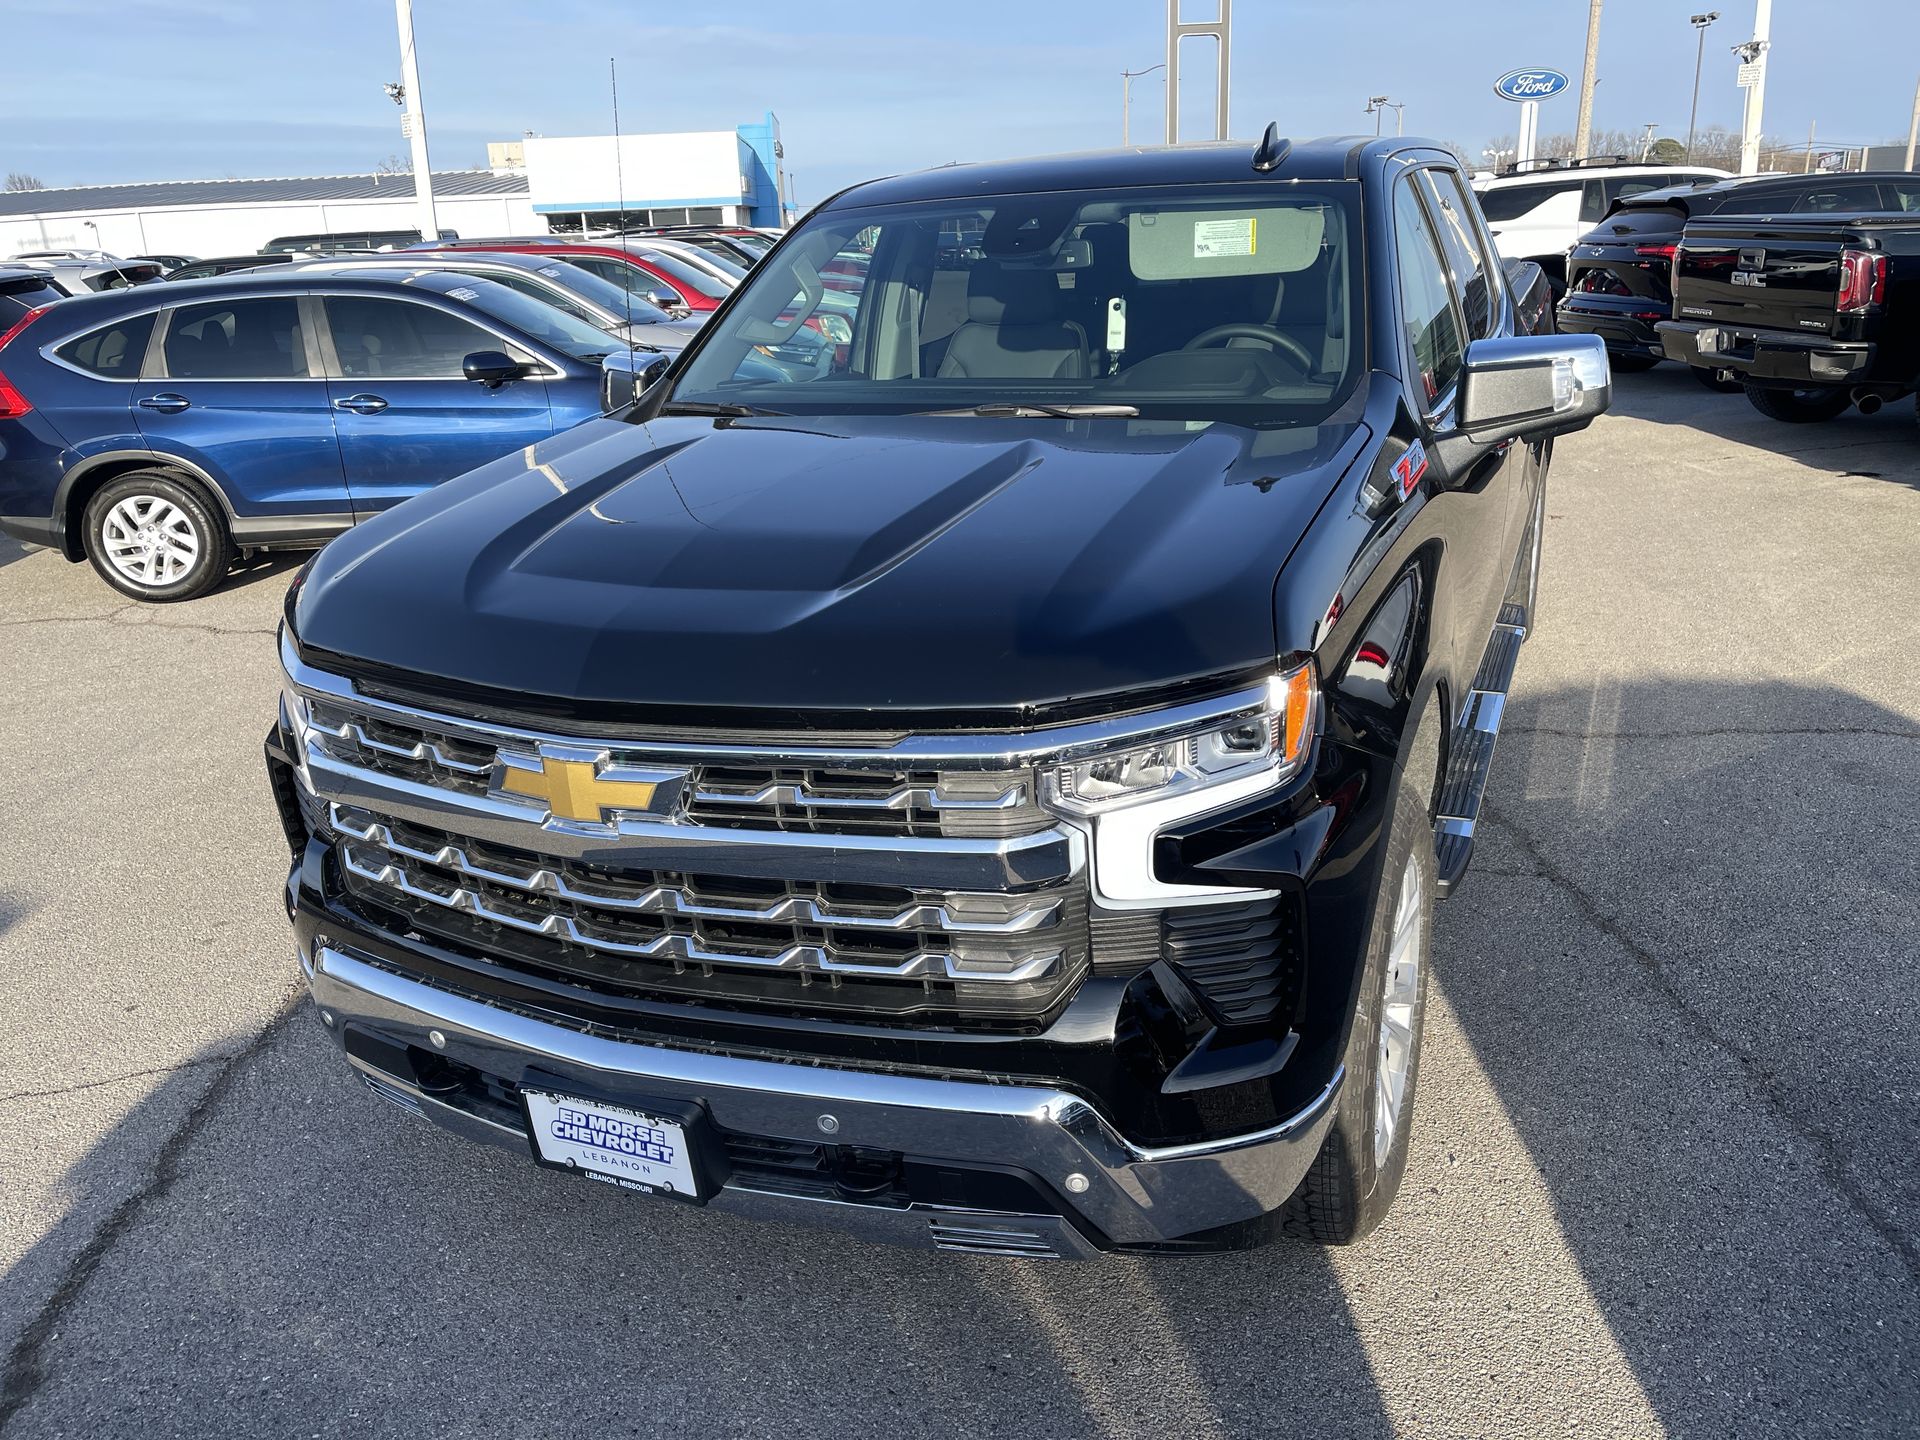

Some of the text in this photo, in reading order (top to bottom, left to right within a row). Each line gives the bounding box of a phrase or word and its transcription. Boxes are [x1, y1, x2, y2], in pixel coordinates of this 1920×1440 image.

[1512, 74, 1555, 94] Ford
[1730, 271, 1767, 288] GMC
[597, 1102, 646, 1119] CHEVROLET
[559, 1107, 666, 1146] ED MORSE
[551, 1119, 674, 1165] CHEVROLET
[582, 1150, 651, 1174] LEBANON
[585, 1171, 653, 1194] LEBANON, MISSOURI
